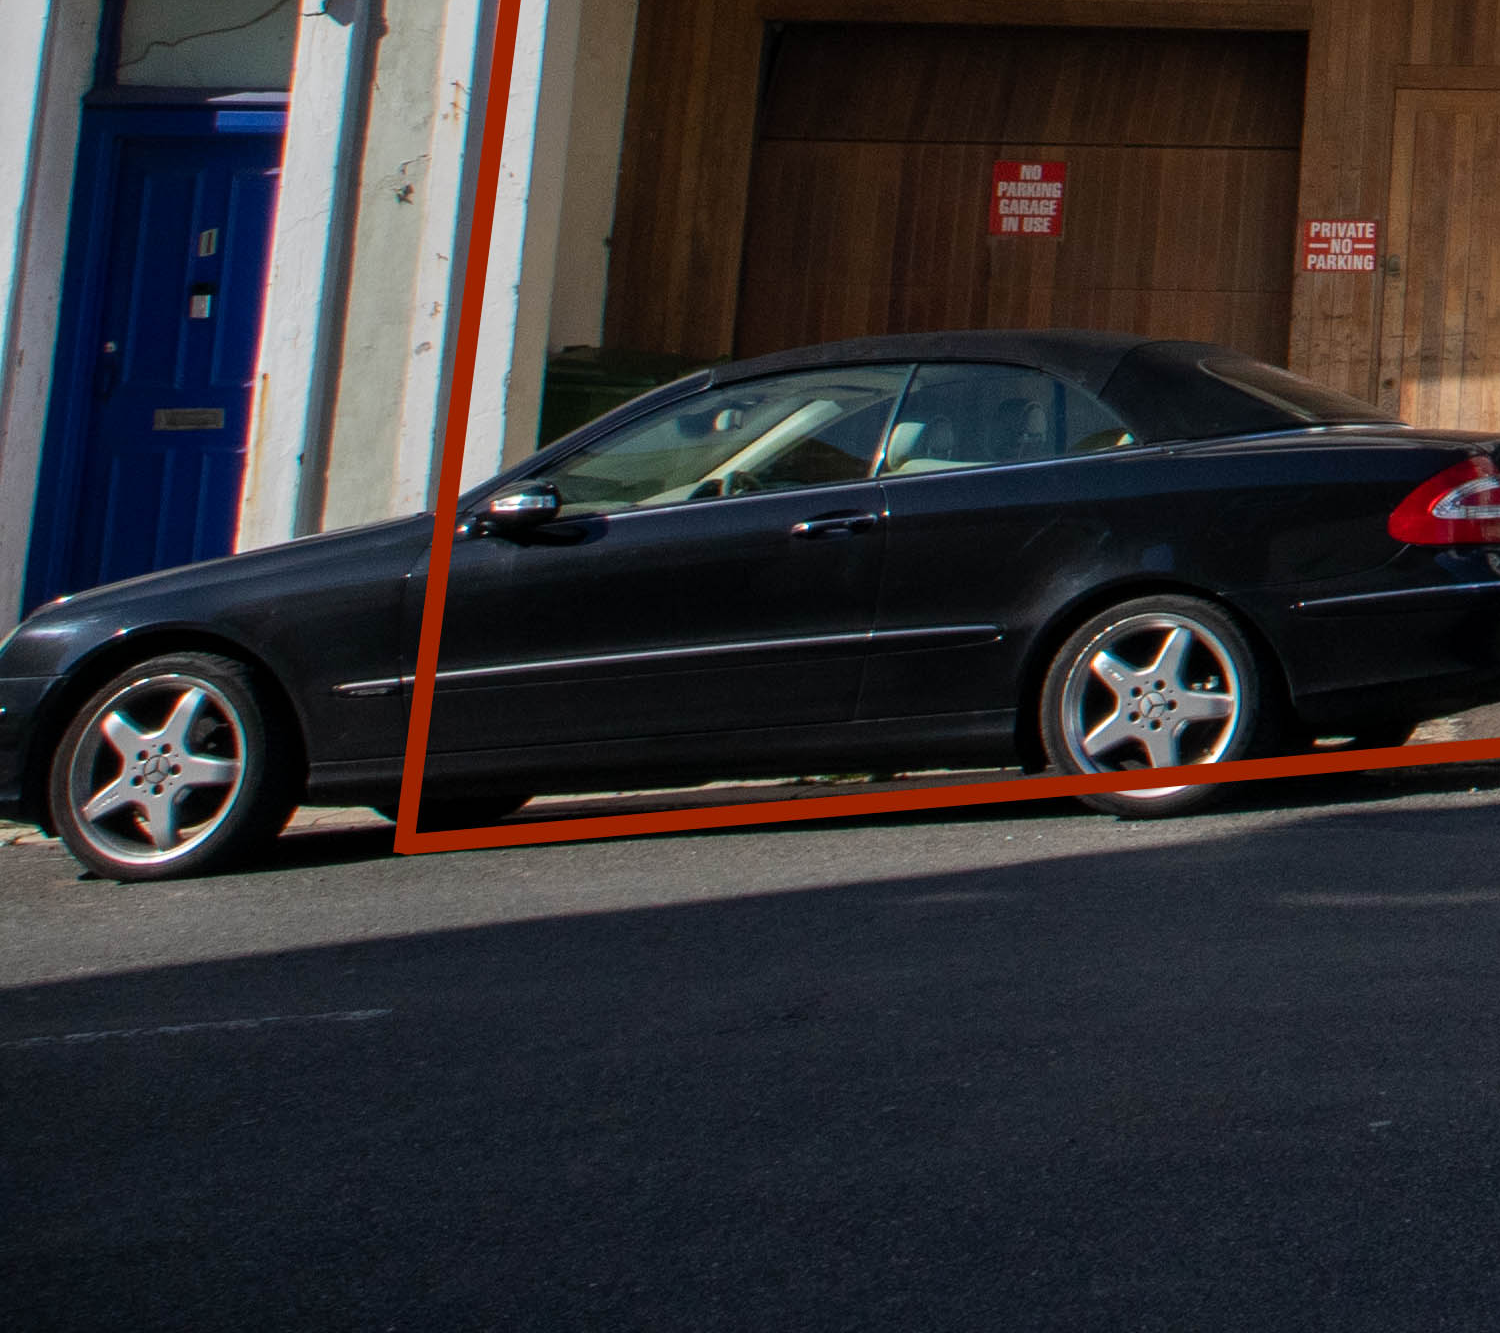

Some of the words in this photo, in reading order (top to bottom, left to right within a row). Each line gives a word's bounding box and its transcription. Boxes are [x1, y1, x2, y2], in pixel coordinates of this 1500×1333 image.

[1020, 165, 1043, 180] NO
[997, 181, 1063, 197] PARKING
[999, 199, 1057, 215] GARAGE
[1001, 216, 1019, 232] IN
[1023, 217, 1052, 232] USE
[1310, 222, 1376, 238] PRIVATE
[1330, 238, 1353, 254] NO
[1307, 254, 1375, 270] PARKING
